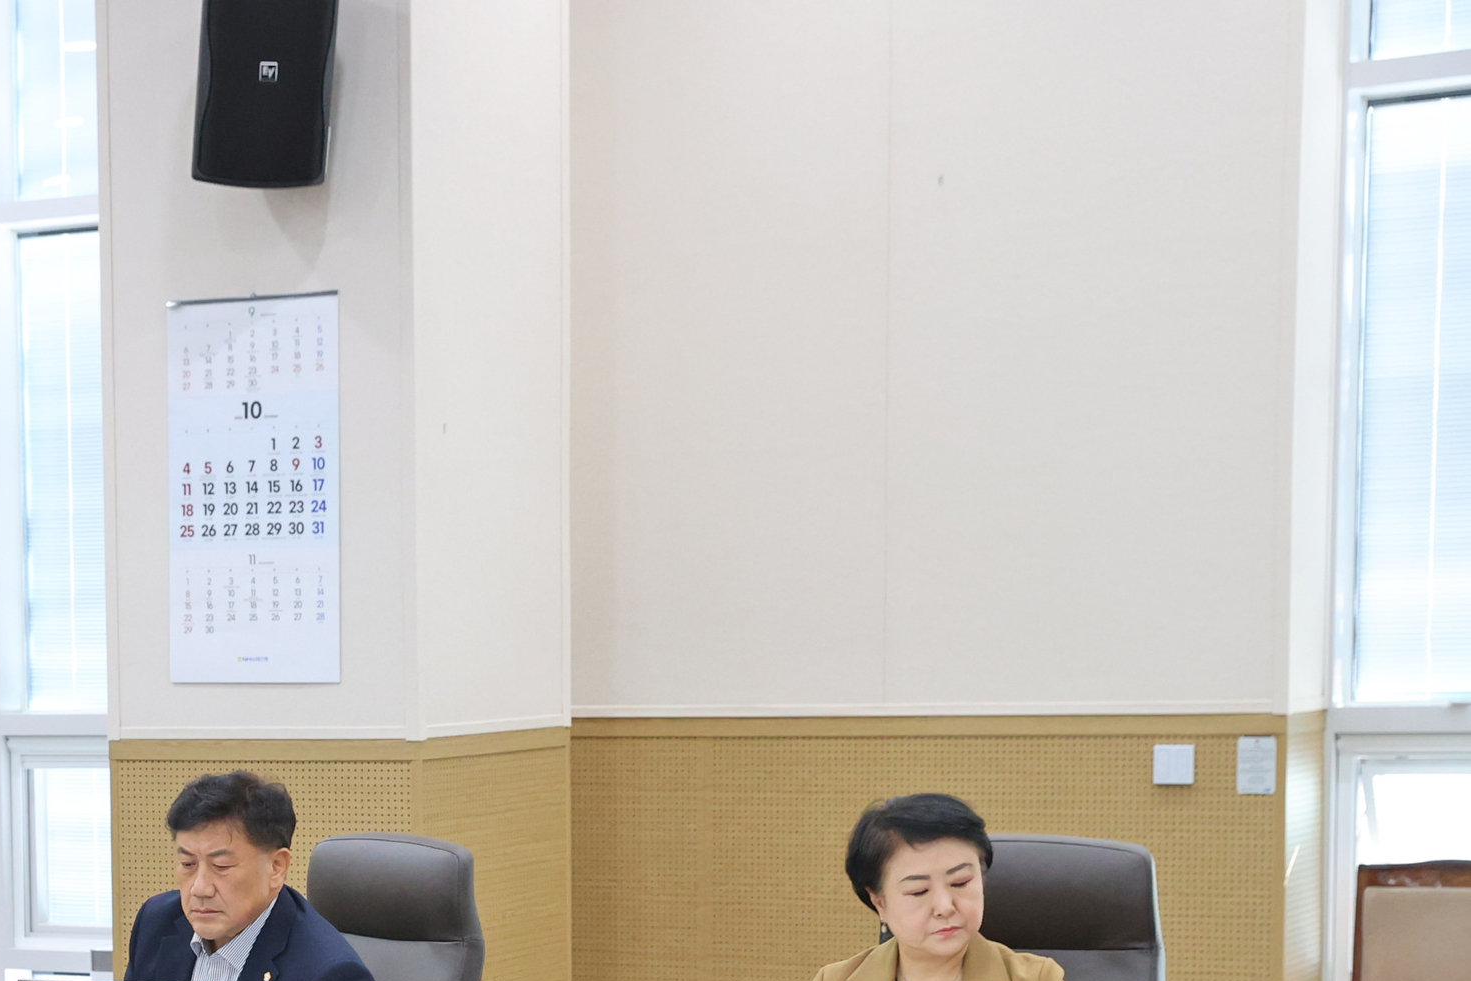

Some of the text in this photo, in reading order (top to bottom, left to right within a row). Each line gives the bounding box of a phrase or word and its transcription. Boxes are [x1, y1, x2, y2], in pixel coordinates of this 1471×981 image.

[248, 306, 255, 317] 9
[242, 401, 262, 419] 10
[271, 435, 323, 451] 1 2 3
[183, 456, 326, 475] 4 5 6 7 8 9 10
[182, 478, 325, 496] 11 12 13 14 15 16 17
[181, 499, 327, 517] 18 19 20 21 22 23 24
[180, 521, 324, 538] 25 26 27 28 29 30 31
[248, 554, 256, 565] 11
[228, 589, 235, 598] 10
[249, 589, 256, 598] 11
[272, 588, 279, 597] 12
[294, 588, 302, 597] 13
[184, 602, 192, 610] 15
[206, 601, 214, 610] 16
[228, 601, 235, 609] 17
[250, 601, 257, 609] 18
[293, 600, 303, 609] 20
[317, 600, 324, 608] 21
[184, 612, 325, 622] 22 23 24 25 26 27 28
[184, 626, 215, 634] 29 30
